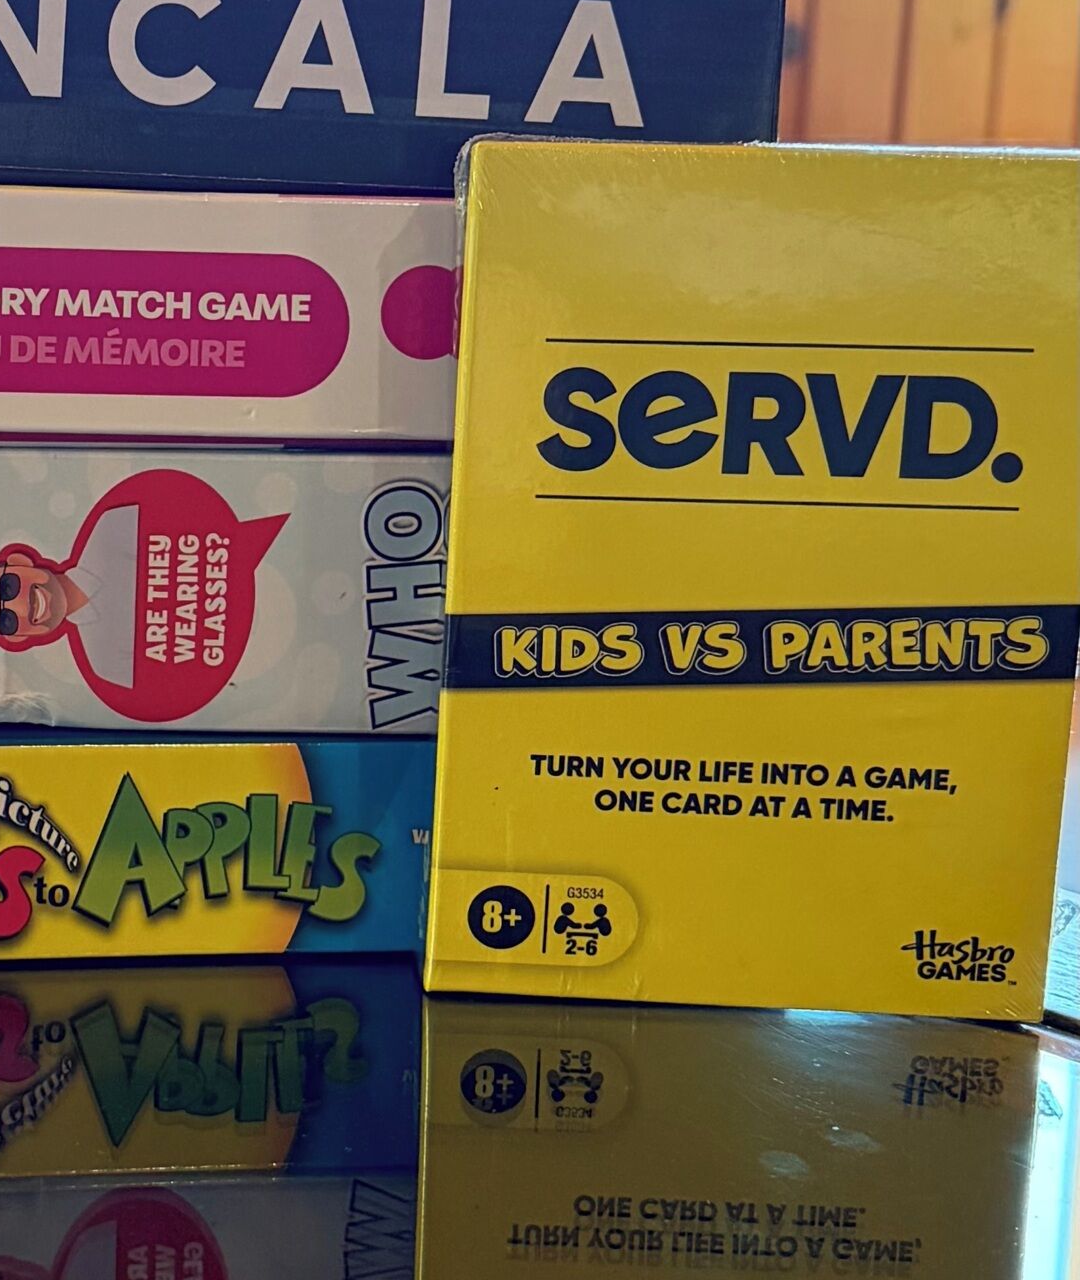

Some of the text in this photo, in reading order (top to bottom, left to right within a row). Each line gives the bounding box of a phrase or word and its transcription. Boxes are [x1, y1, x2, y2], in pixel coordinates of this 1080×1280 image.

[53, 287, 192, 321] MATCH
[197, 291, 312, 323] GAME
[8, 334, 56, 364] DE
[63, 328, 246, 369] MÉMOIRE
[144, 534, 172, 663] ARE THEY
[173, 533, 200, 664] WEARING
[203, 532, 233, 667] GLASSES?
[362, 482, 445, 731] WHO
[495, 617, 1049, 677] KIDS VS PARENTS
[530, 754, 958, 796] TURN YOUR LIFE INTO A GAME,
[594, 789, 895, 823] ONE CARD AT A TIME.
[34, 874, 70, 909] to
[71, 772, 382, 929] APPLES
[566, 886, 605, 901] G3534
[481, 900, 522, 934] 8+
[564, 938, 598, 958] 2-6
[901, 929, 1016, 967] Hasbro
[917, 961, 1008, 983] GAMES
